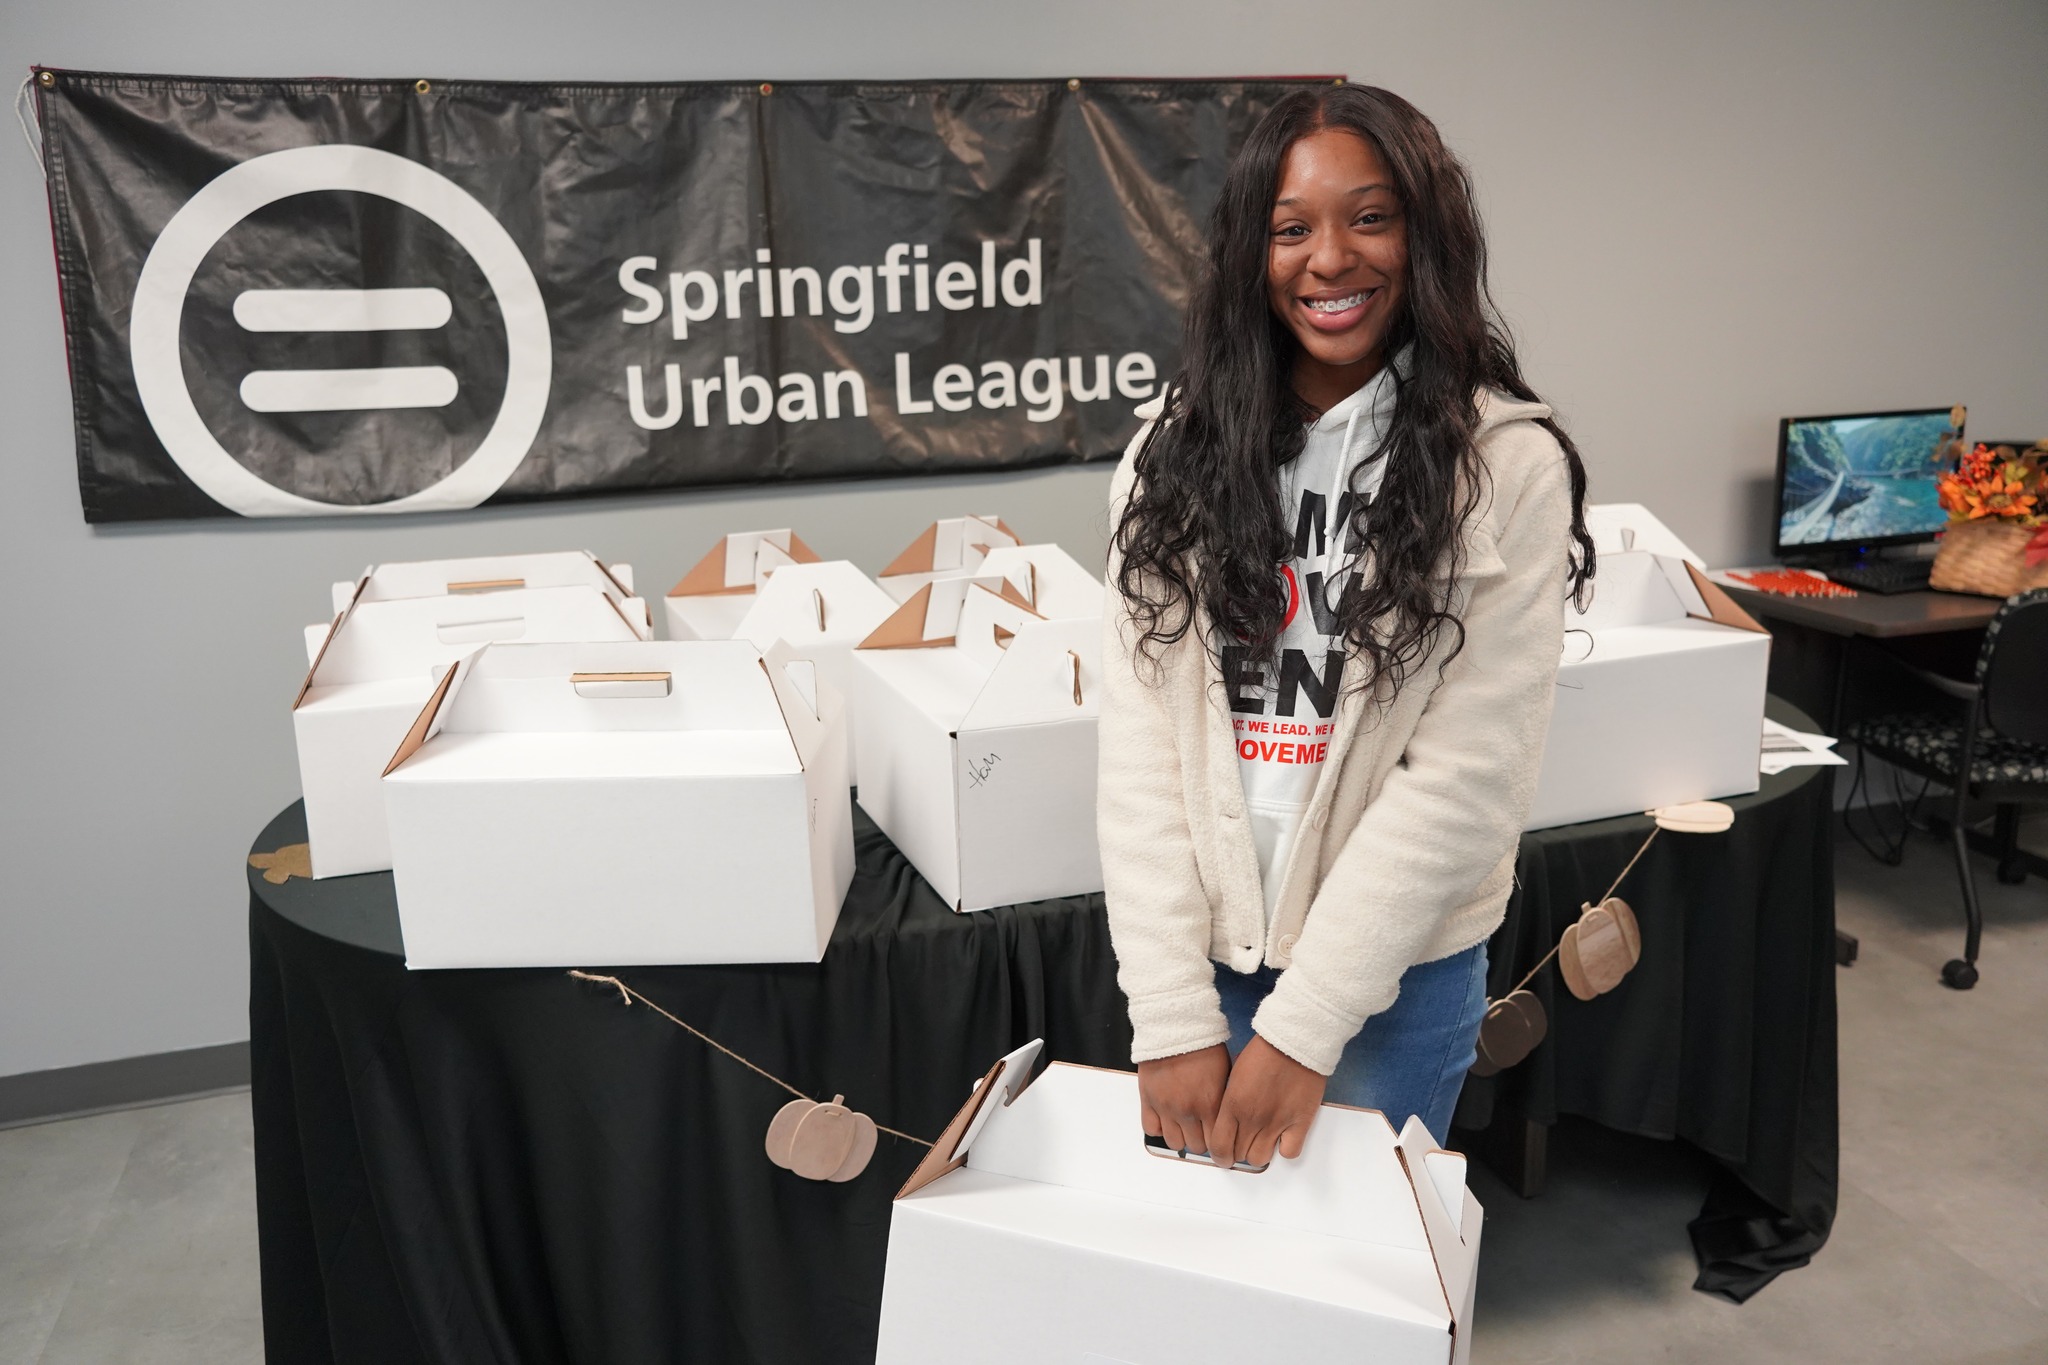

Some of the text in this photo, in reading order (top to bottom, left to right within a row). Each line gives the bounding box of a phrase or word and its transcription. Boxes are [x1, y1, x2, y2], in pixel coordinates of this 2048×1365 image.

[617, 238, 1043, 341] Springfield
[626, 355, 869, 431] Urban
[1235, 738, 1328, 765] OVEME
[1248, 721, 1269, 733] WE
[1273, 723, 1311, 736] LEAD.
[1315, 724, 1329, 736] WE
